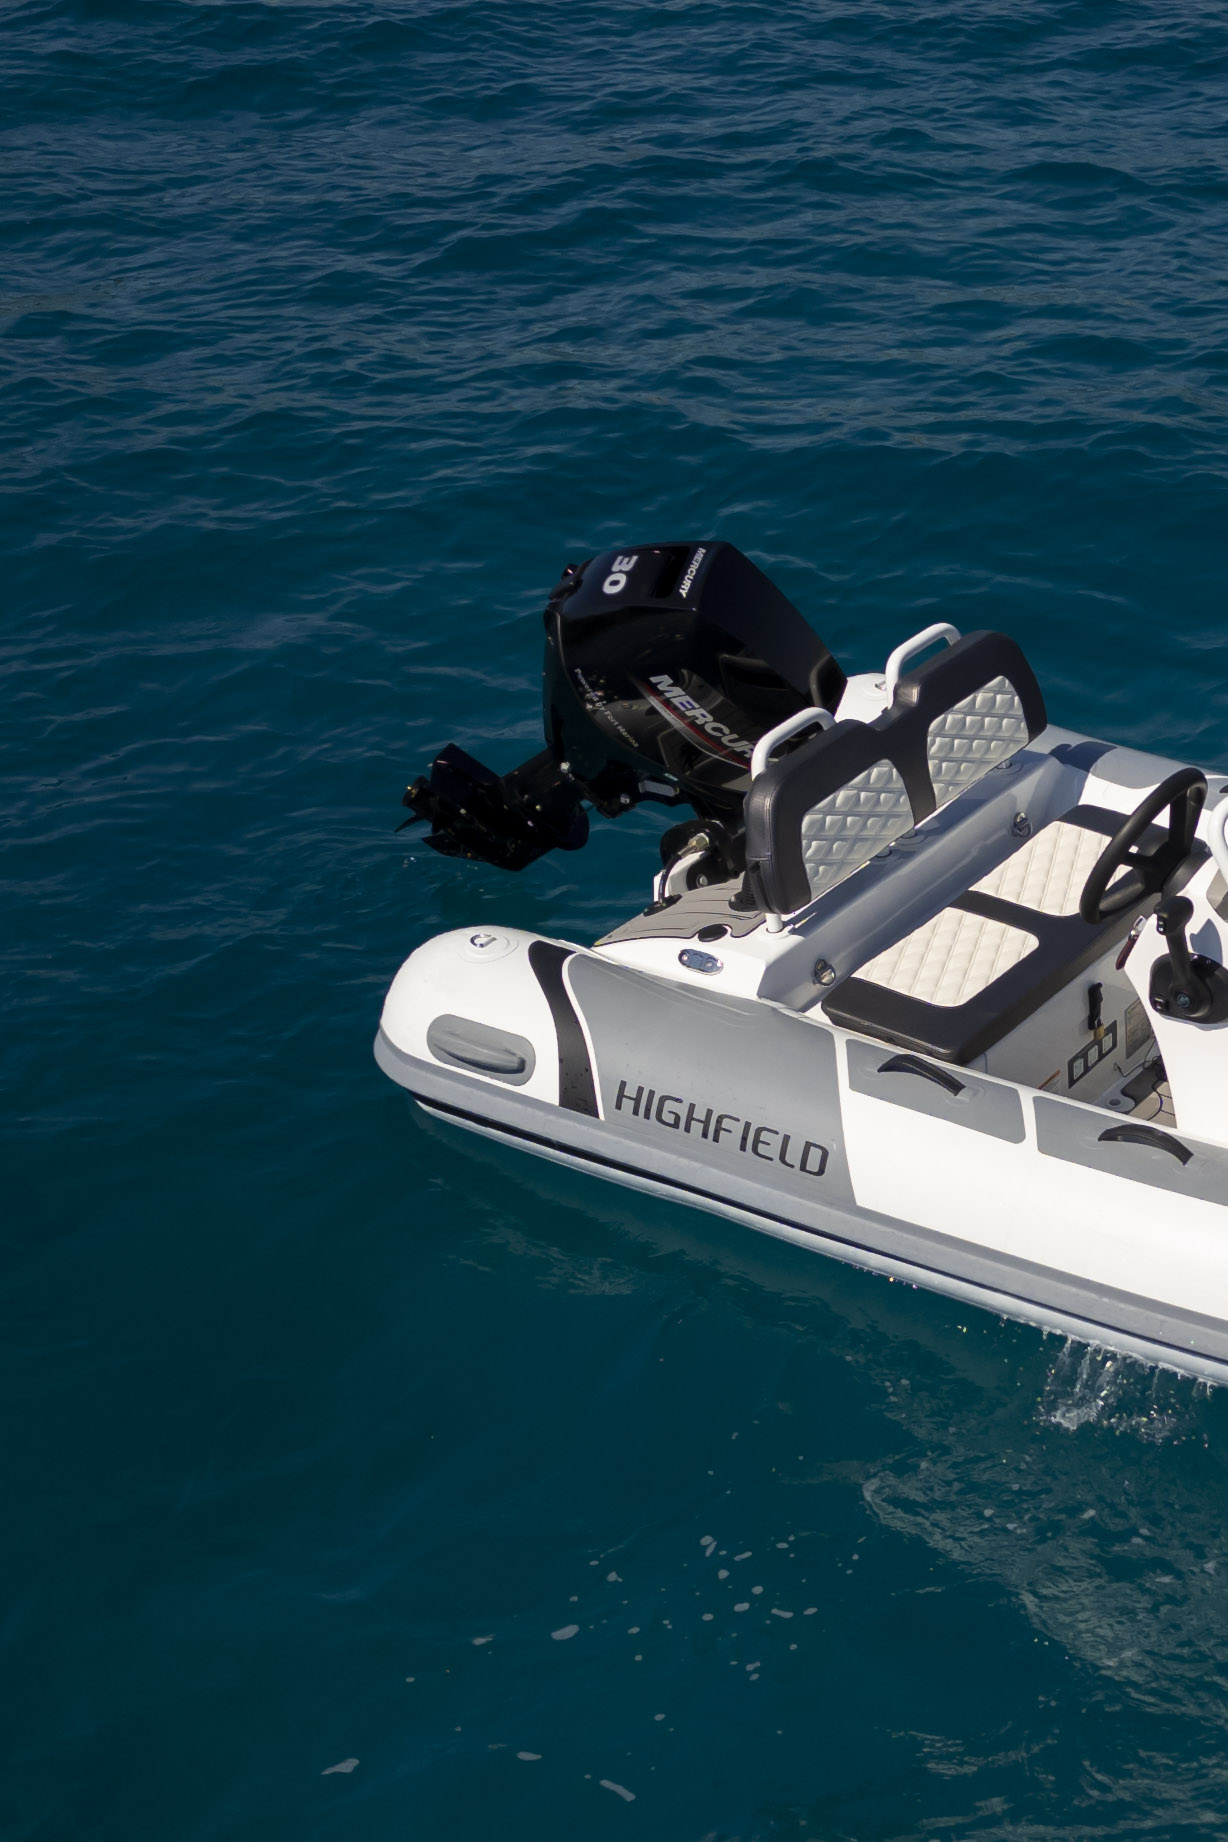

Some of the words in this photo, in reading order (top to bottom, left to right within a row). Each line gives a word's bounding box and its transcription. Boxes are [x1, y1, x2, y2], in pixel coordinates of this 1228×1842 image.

[602, 555, 639, 595] 30
[679, 547, 707, 599] MERCURY
[648, 674, 779, 762] MERCUR
[614, 1079, 830, 1177] HIGHFIELD
